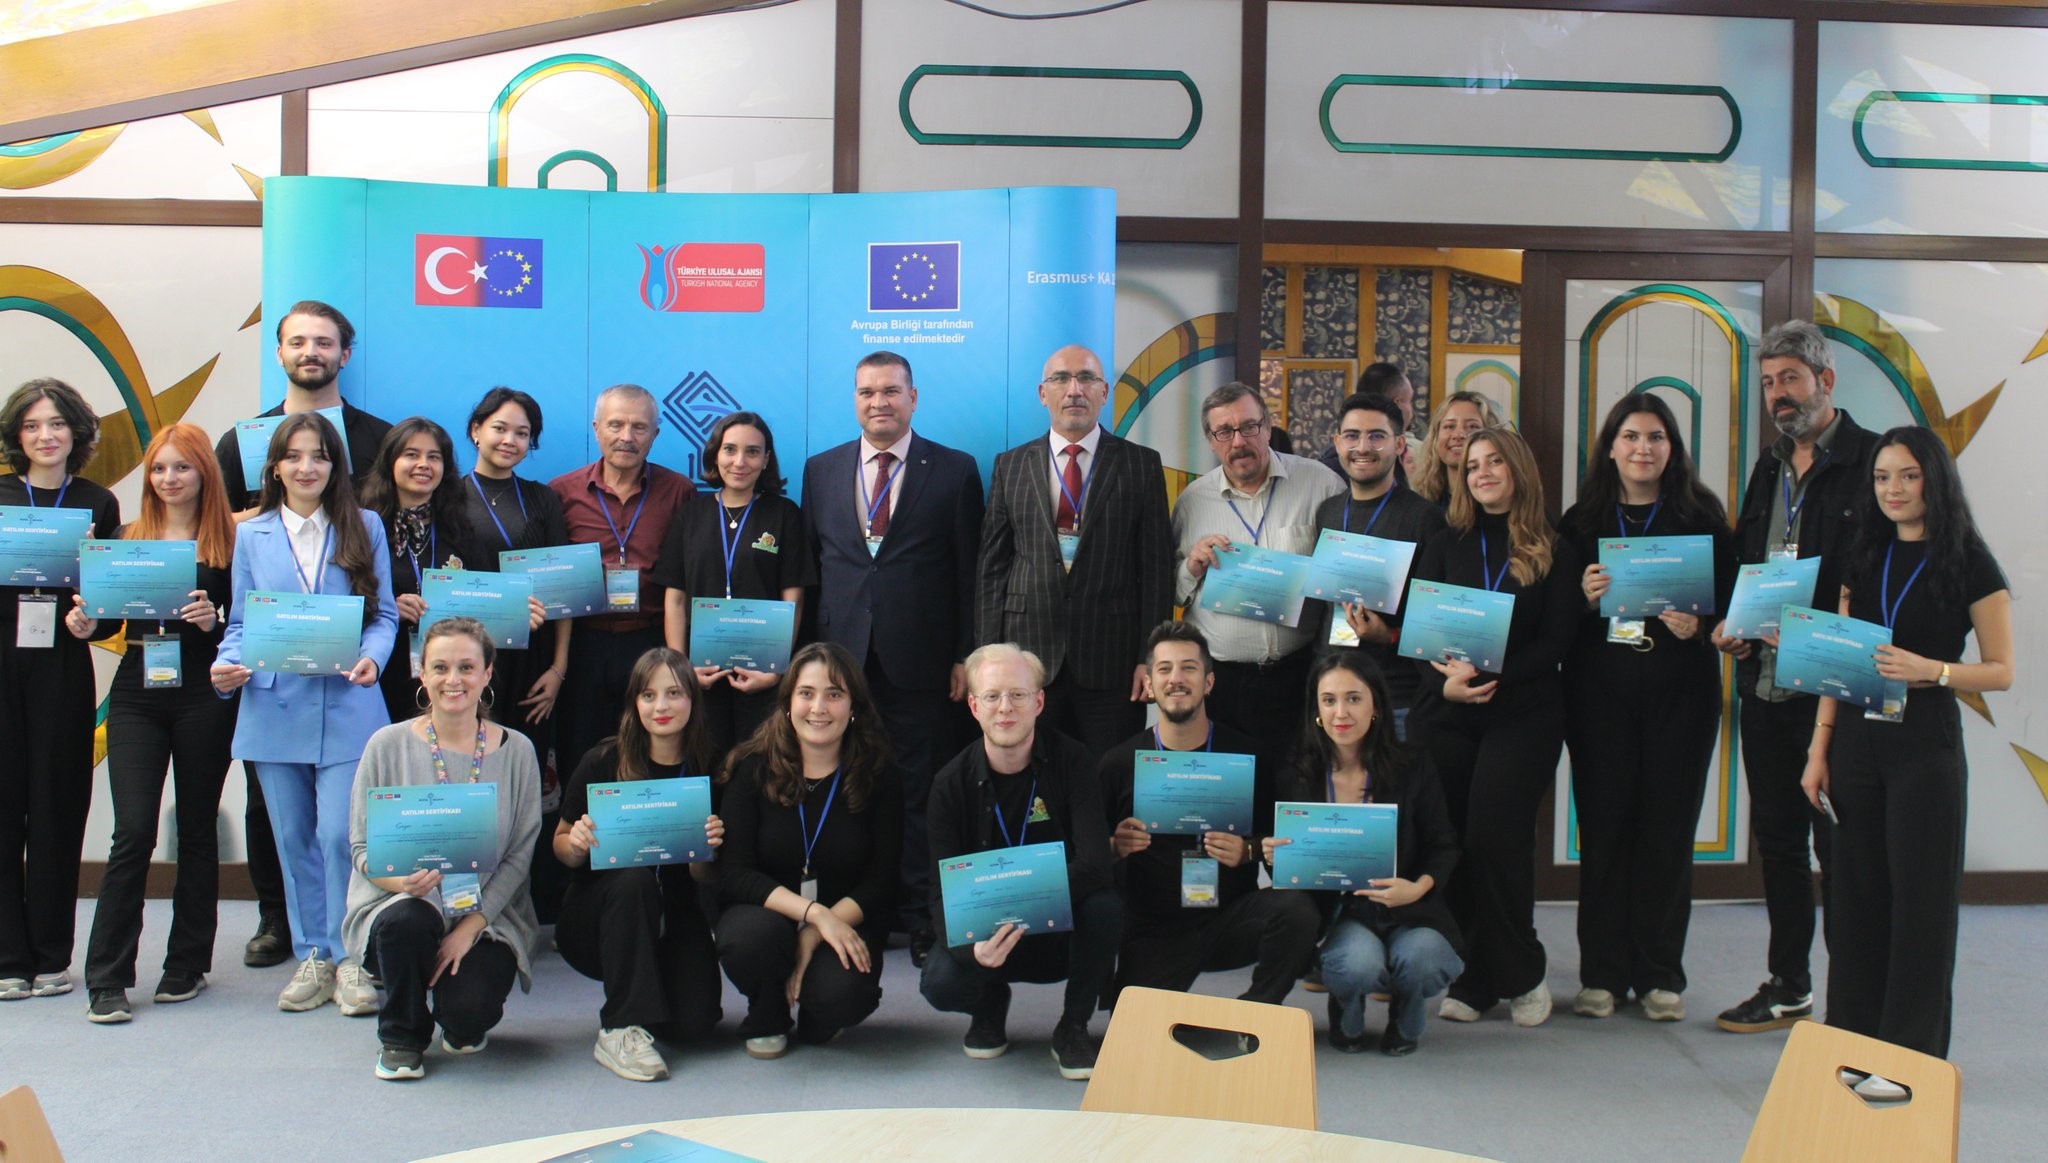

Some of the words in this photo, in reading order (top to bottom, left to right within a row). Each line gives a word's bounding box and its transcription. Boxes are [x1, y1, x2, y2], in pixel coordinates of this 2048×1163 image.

[677, 266, 707, 276] TÜRKİYE
[708, 267, 736, 276] ULUSAL
[736, 268, 763, 276] AJANSI
[1027, 271, 1095, 284] Erasmus+
[681, 279, 706, 287] TURKISH
[706, 279, 734, 288] NATIONAL
[735, 280, 759, 288] AGENCY
[851, 319, 889, 332] Avrupa
[890, 319, 922, 332] Birliği
[923, 319, 974, 330] tarafından
[863, 333, 901, 344] finanse
[903, 333, 966, 344] edilmektedir
